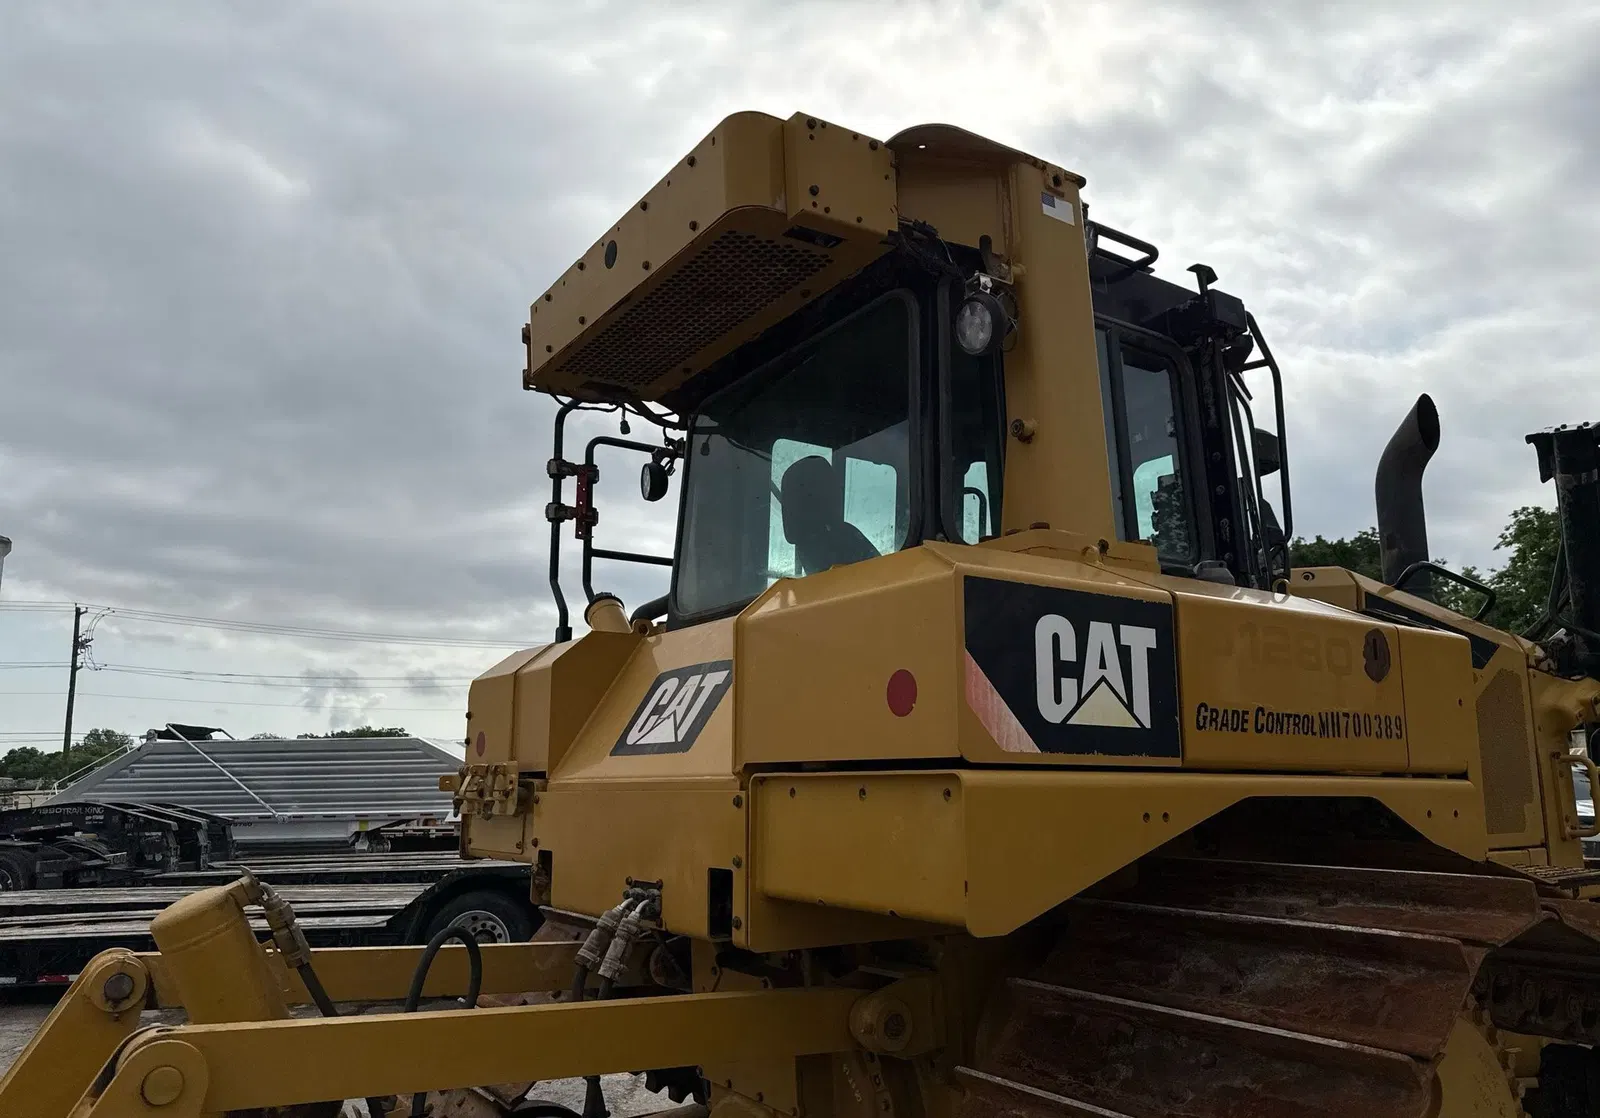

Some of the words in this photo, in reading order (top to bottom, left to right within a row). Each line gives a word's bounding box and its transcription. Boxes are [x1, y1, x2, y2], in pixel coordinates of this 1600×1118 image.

[626, 669, 730, 746] CAT
[1035, 613, 1157, 729] CAT
[61, 806, 83, 815] TRAIL
[85, 806, 105, 814] KING
